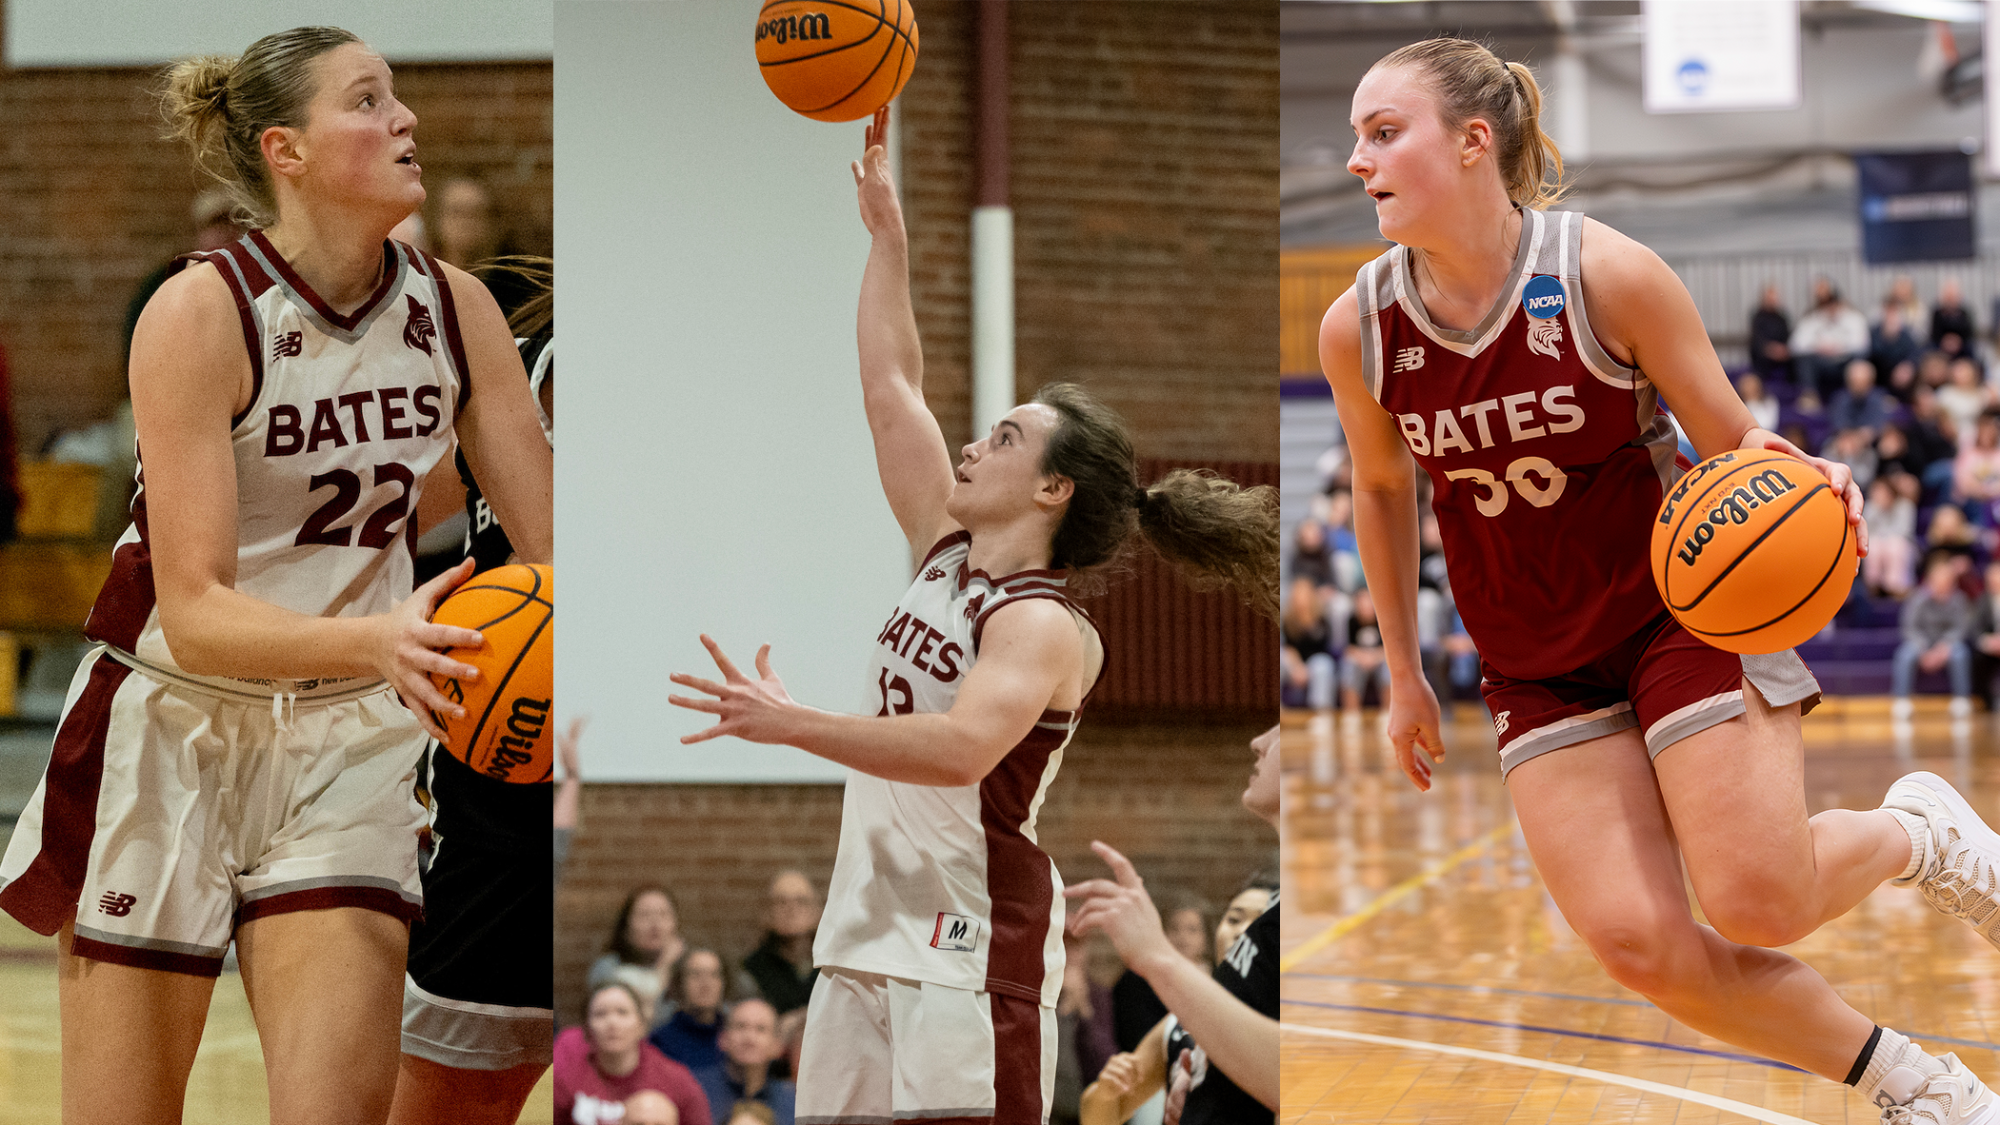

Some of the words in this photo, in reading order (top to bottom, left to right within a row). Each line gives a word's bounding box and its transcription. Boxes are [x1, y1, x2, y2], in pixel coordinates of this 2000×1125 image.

[1529, 295, 1564, 309] NCAA
[264, 385, 442, 457] BATES
[1393, 385, 1585, 457] BATES
[294, 462, 415, 549] 22
[1444, 456, 1567, 517] 30
[1659, 453, 1737, 525] NCAA
[1678, 469, 1797, 567] Wilson
[1717, 482, 1735, 497] EVO
[878, 606, 964, 682] ATES
[948, 920, 967, 939] M
